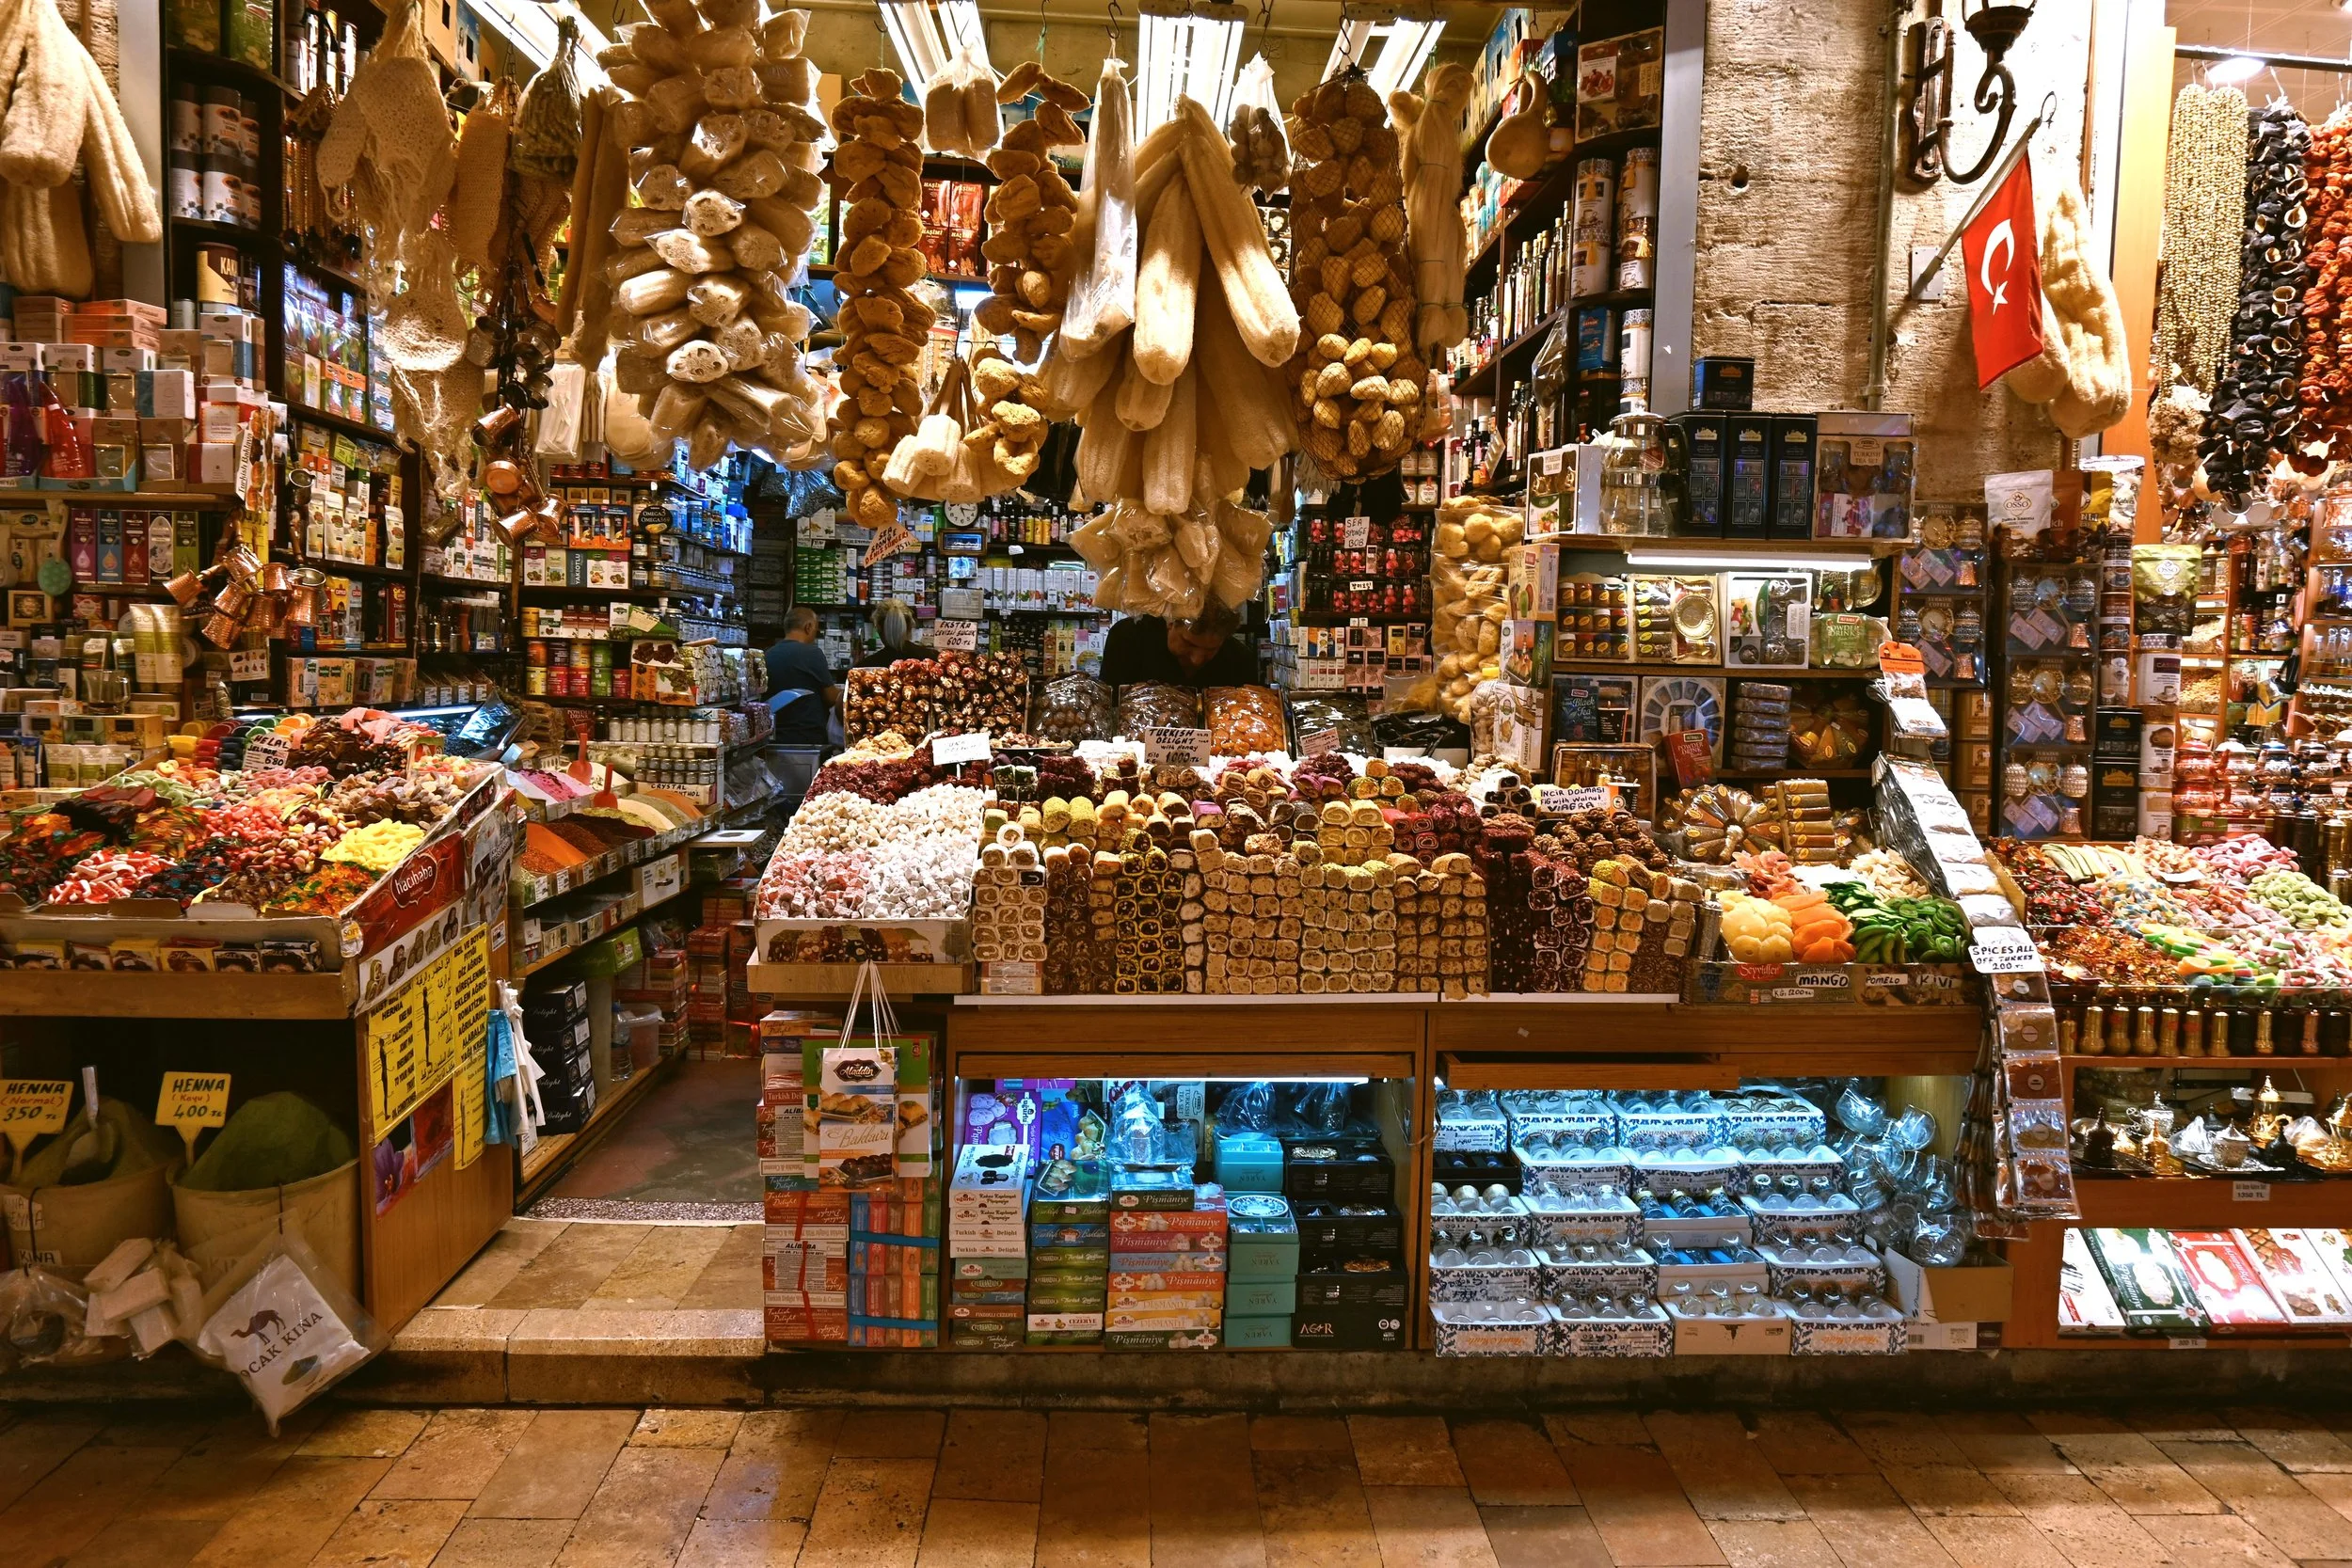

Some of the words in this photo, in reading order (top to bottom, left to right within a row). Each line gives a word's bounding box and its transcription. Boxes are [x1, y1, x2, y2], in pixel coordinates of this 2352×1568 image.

[253, 735, 289, 749] HELAL
[264, 755, 283, 766] 680
[1568, 786, 1605, 796] DOLMASI
[1798, 975, 1849, 987] MANGO
[1867, 976, 1900, 985] POMELO
[840, 1065, 874, 1078] Aladdin
[7, 1083, 66, 1094] HENNA
[172, 1079, 225, 1092] HENNA
[3, 1106, 42, 1121] 350
[173, 1104, 208, 1119] 400
[839, 1126, 889, 1148] Baklava
[775, 1181, 797, 1191] Delight
[772, 1197, 797, 1207] Delight
[773, 1314, 797, 1323] Delight
[280, 1311, 324, 1347] KINA
